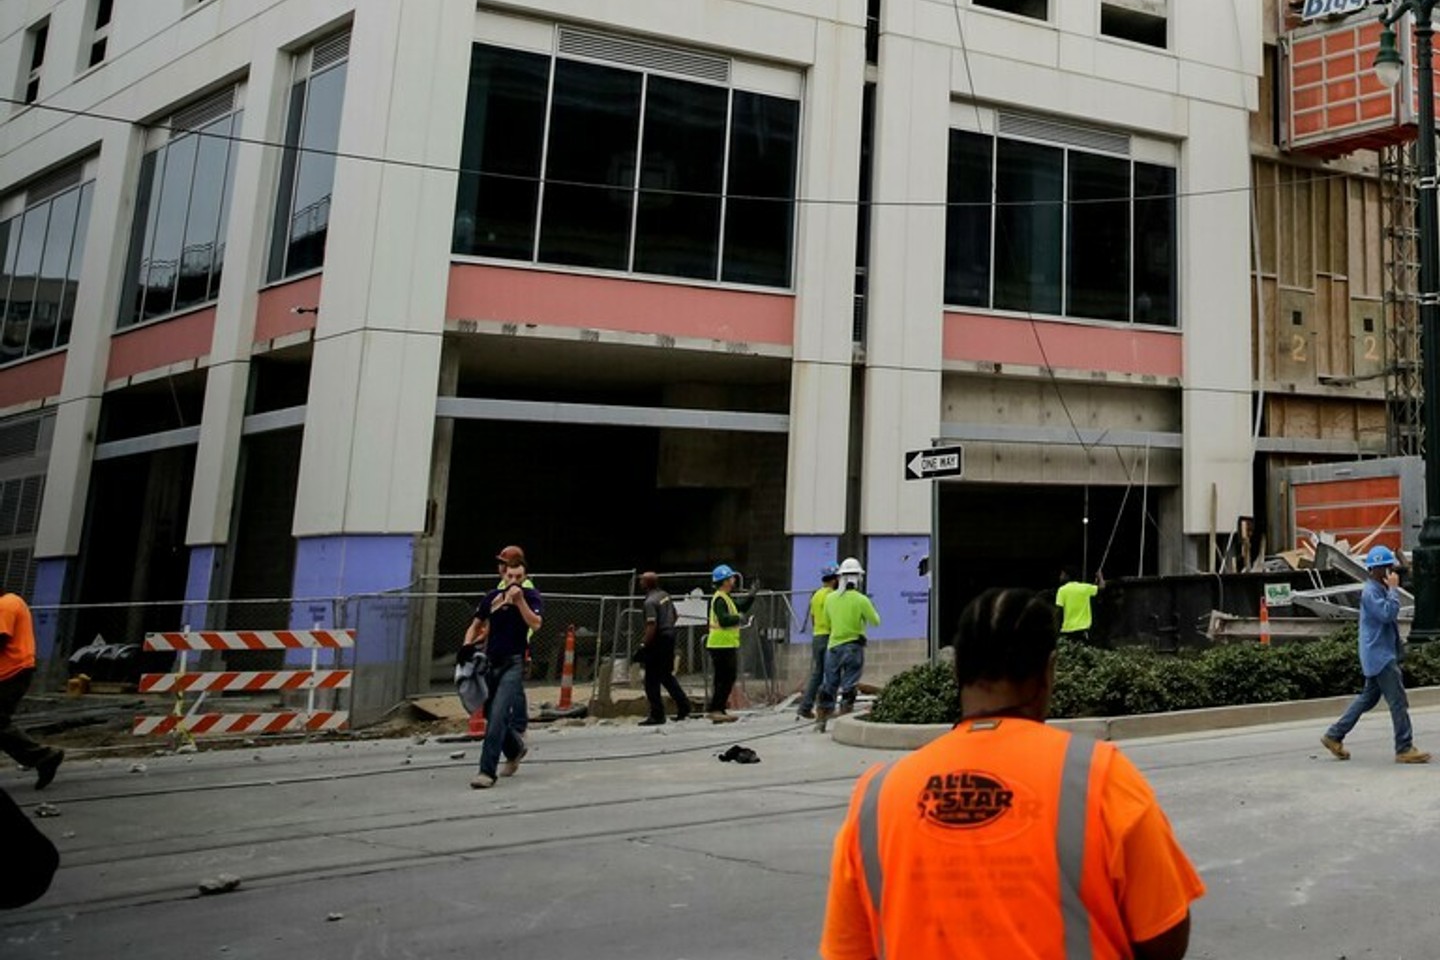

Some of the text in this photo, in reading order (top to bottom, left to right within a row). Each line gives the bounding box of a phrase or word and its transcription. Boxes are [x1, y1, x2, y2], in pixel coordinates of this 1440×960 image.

[1292, 334, 1306, 361] 2
[1364, 335, 1379, 361] 2
[921, 456, 956, 470] ONE WAY
[926, 773, 975, 790] ALL
[941, 790, 1014, 811] STAR
